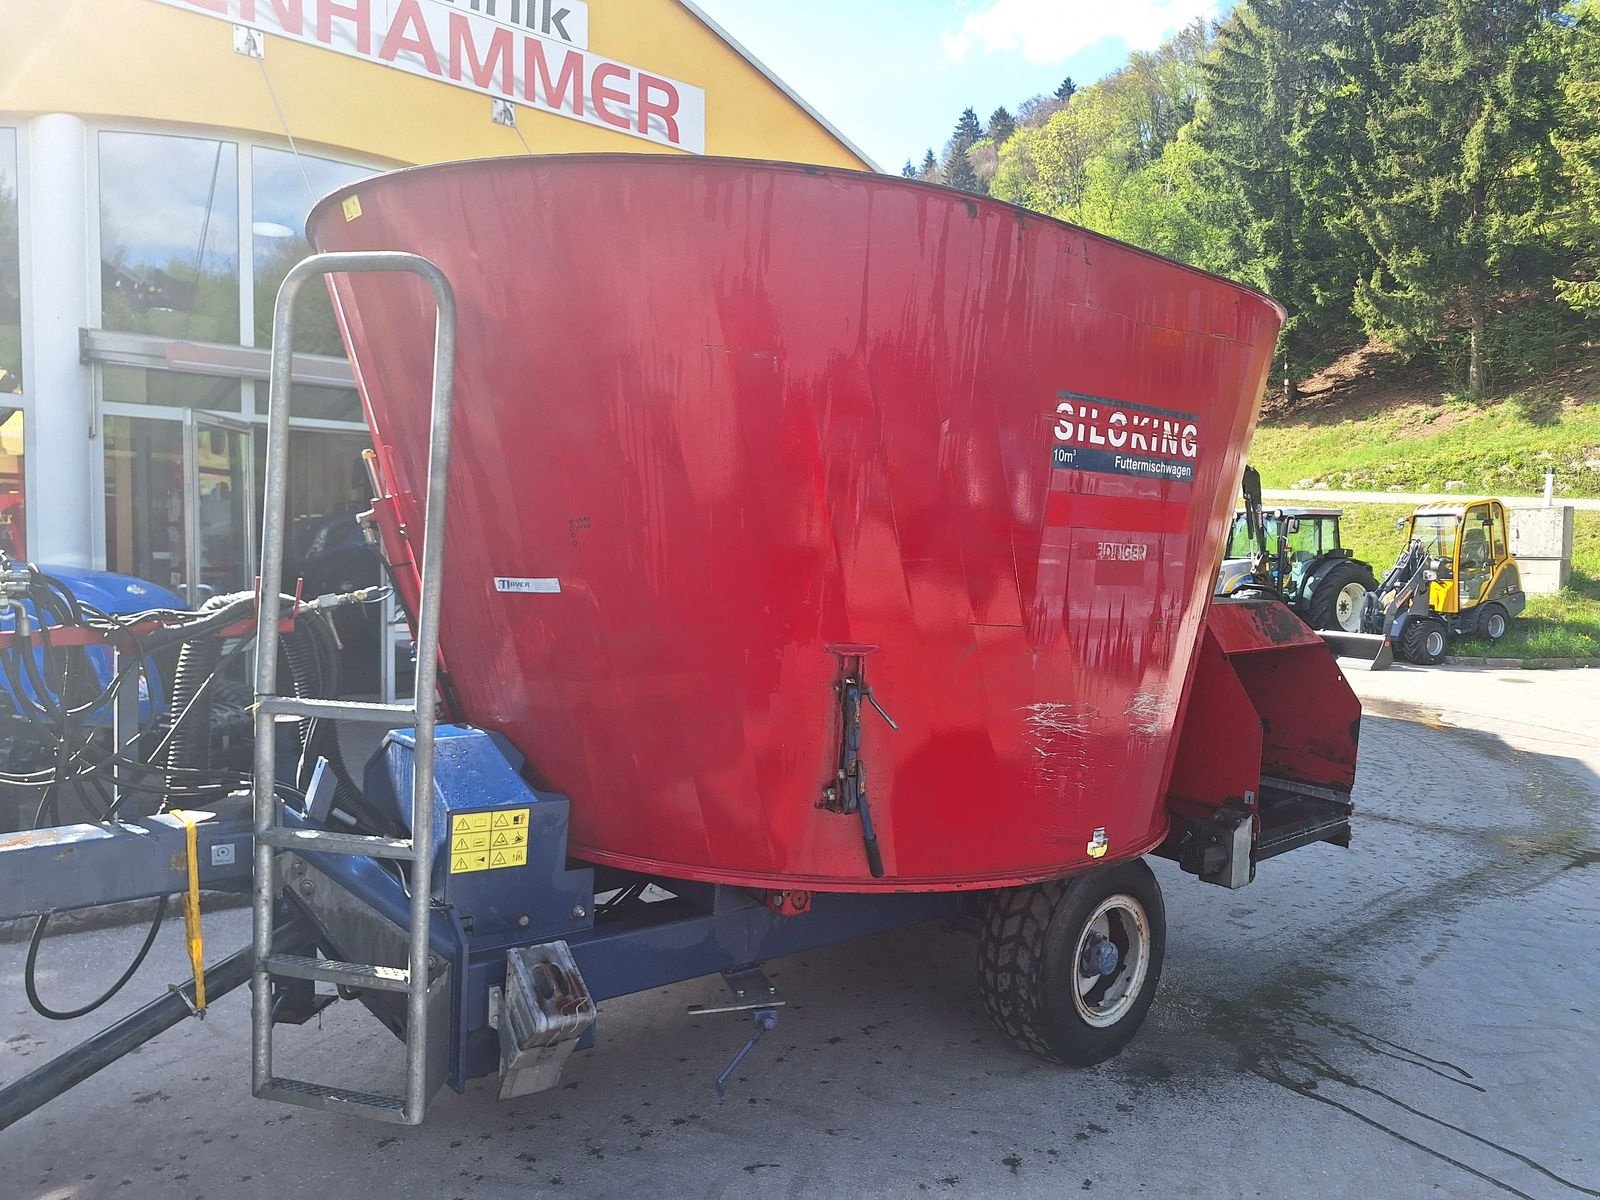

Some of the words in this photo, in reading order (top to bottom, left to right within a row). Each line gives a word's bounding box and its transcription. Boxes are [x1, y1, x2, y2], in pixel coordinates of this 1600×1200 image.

[186, 0, 681, 144] HAMMER
[1054, 402, 1198, 458] SILOKING
[1114, 455, 1191, 478] Futtermischwagen
